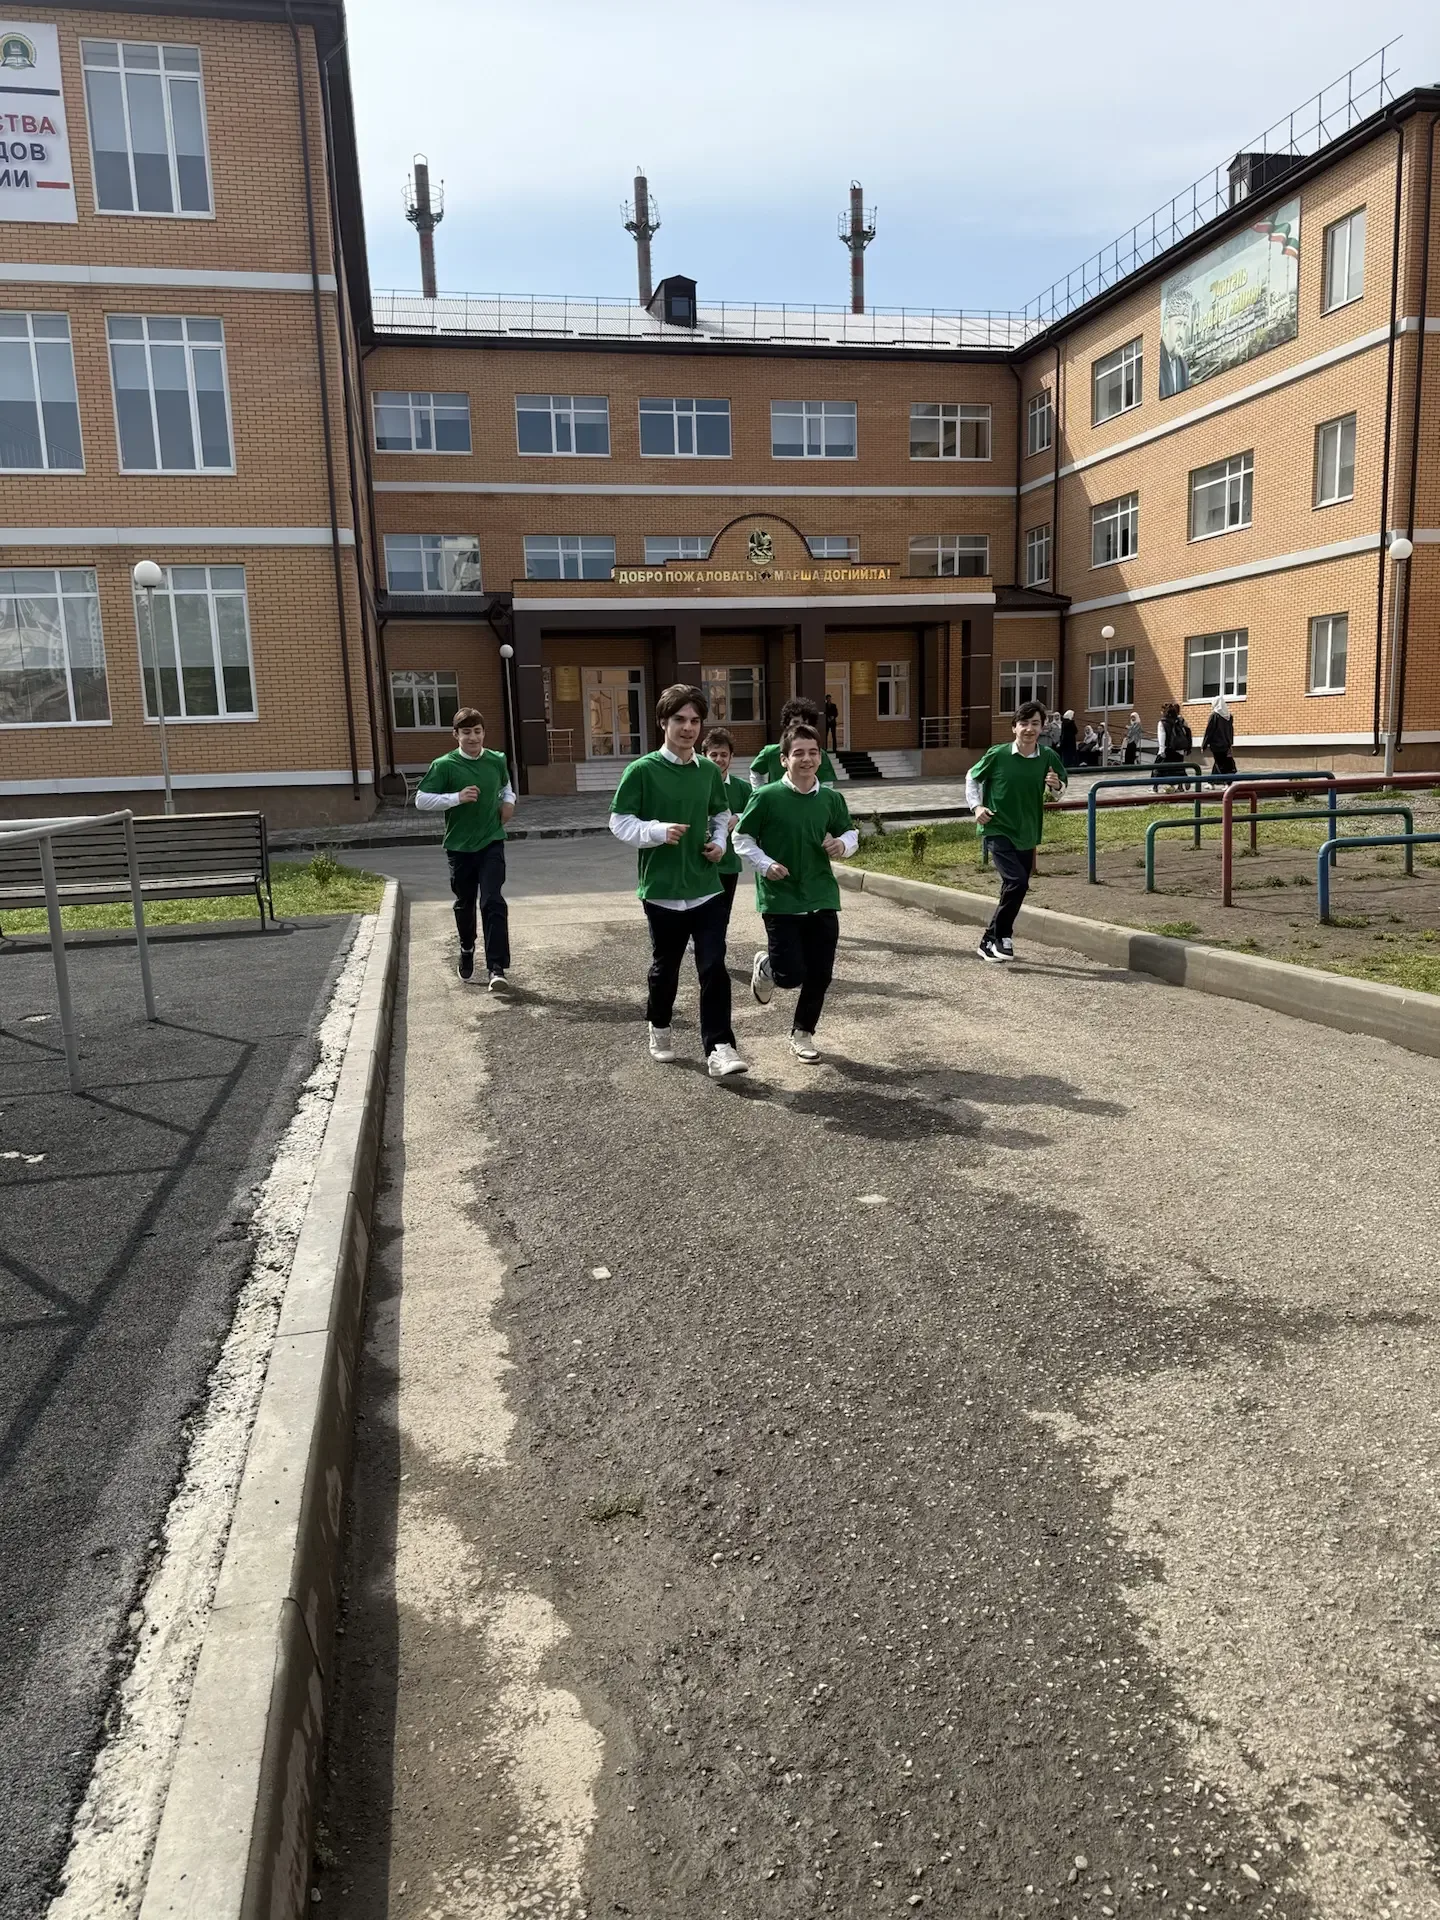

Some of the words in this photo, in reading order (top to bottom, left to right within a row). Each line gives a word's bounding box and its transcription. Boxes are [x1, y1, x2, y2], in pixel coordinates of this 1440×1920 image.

[0, 114, 56, 135] ТВА
[619, 570, 663, 584] ДОБРО
[665, 570, 757, 583] ПОЖАЛОВАТЬ!
[774, 569, 821, 581] МАРША
